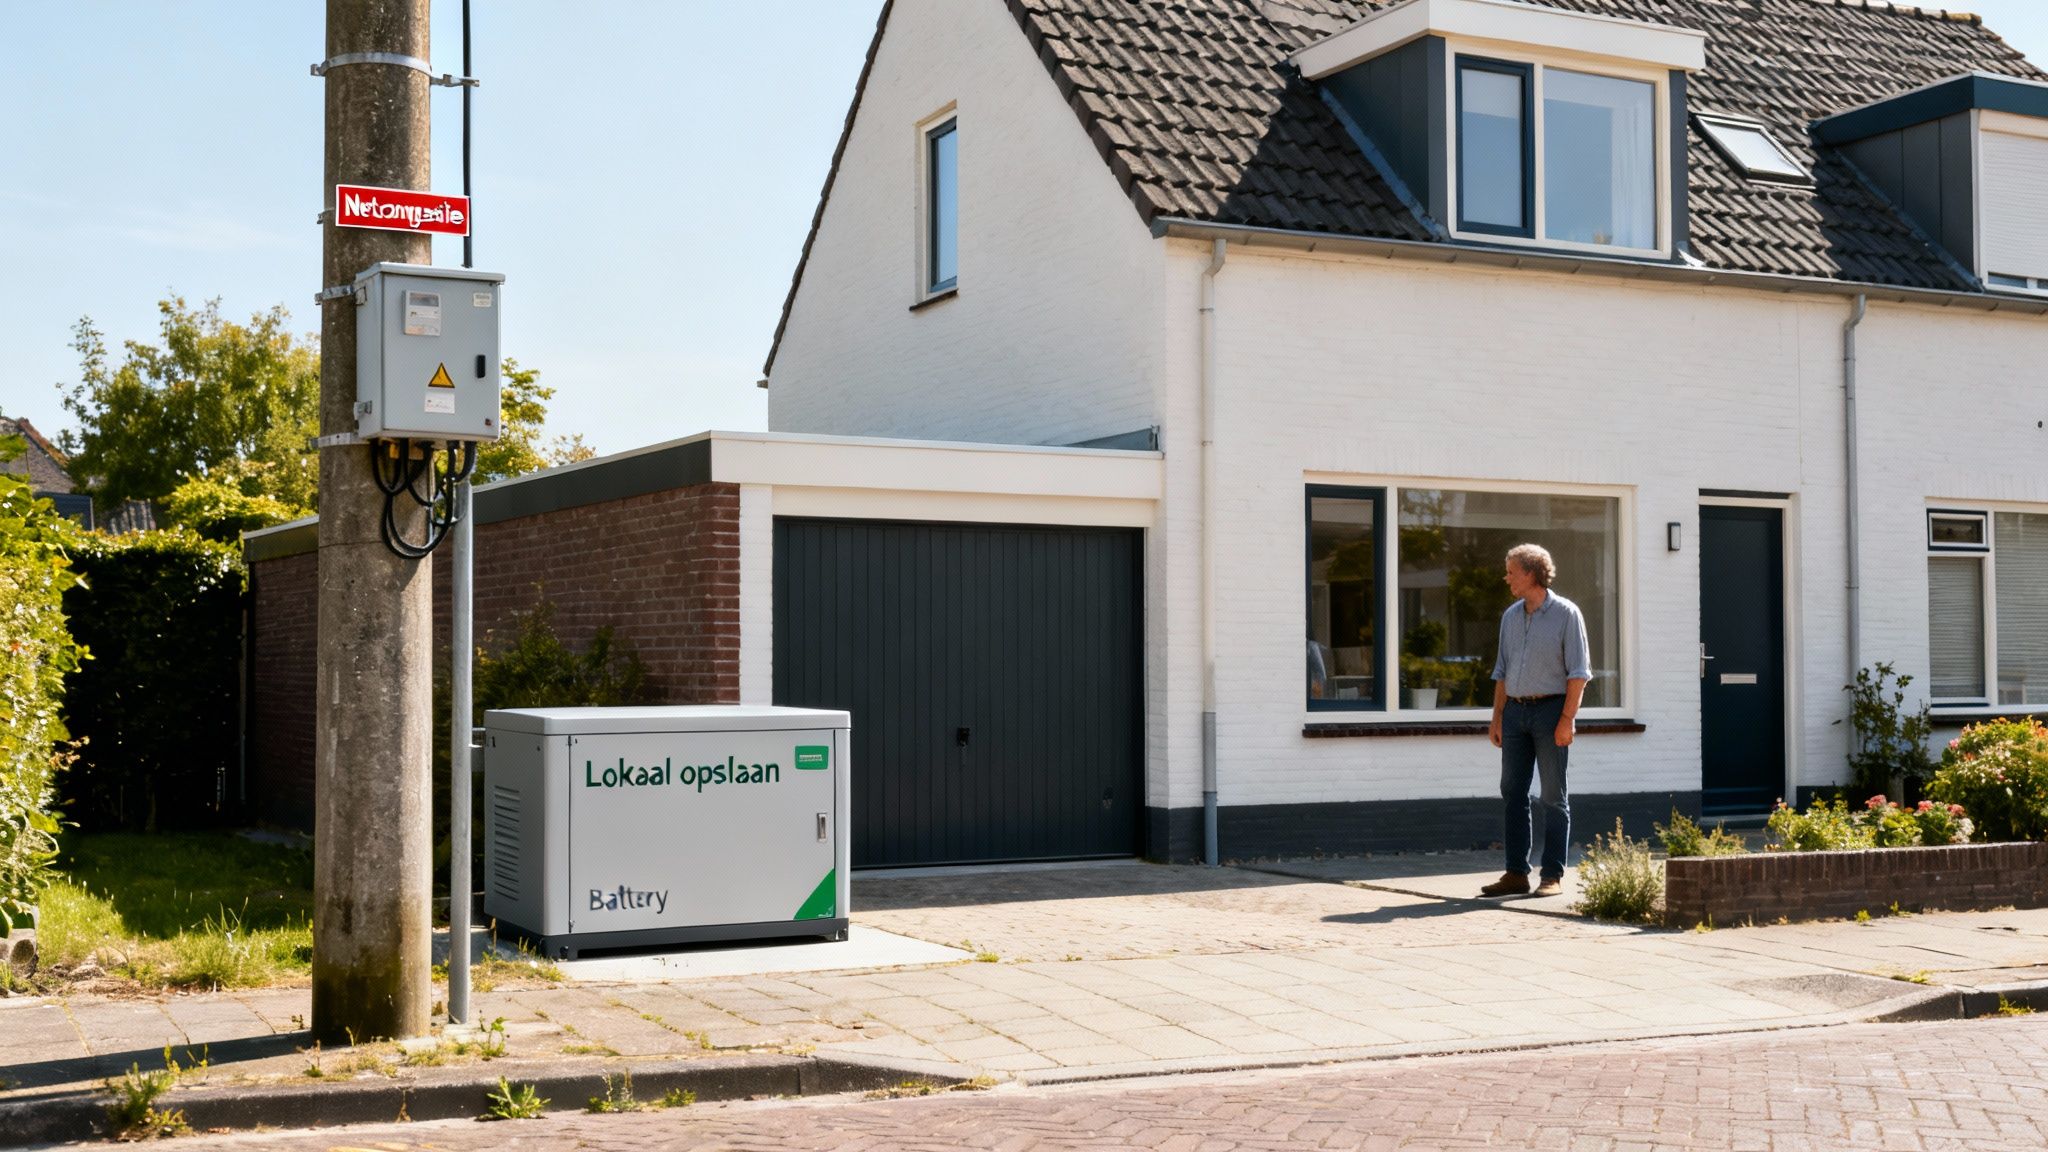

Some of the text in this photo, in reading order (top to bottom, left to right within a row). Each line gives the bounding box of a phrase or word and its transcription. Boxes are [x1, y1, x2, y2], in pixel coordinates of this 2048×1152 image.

[586, 756, 780, 793] Lokaal opslaan
[589, 884, 668, 914] Battery
